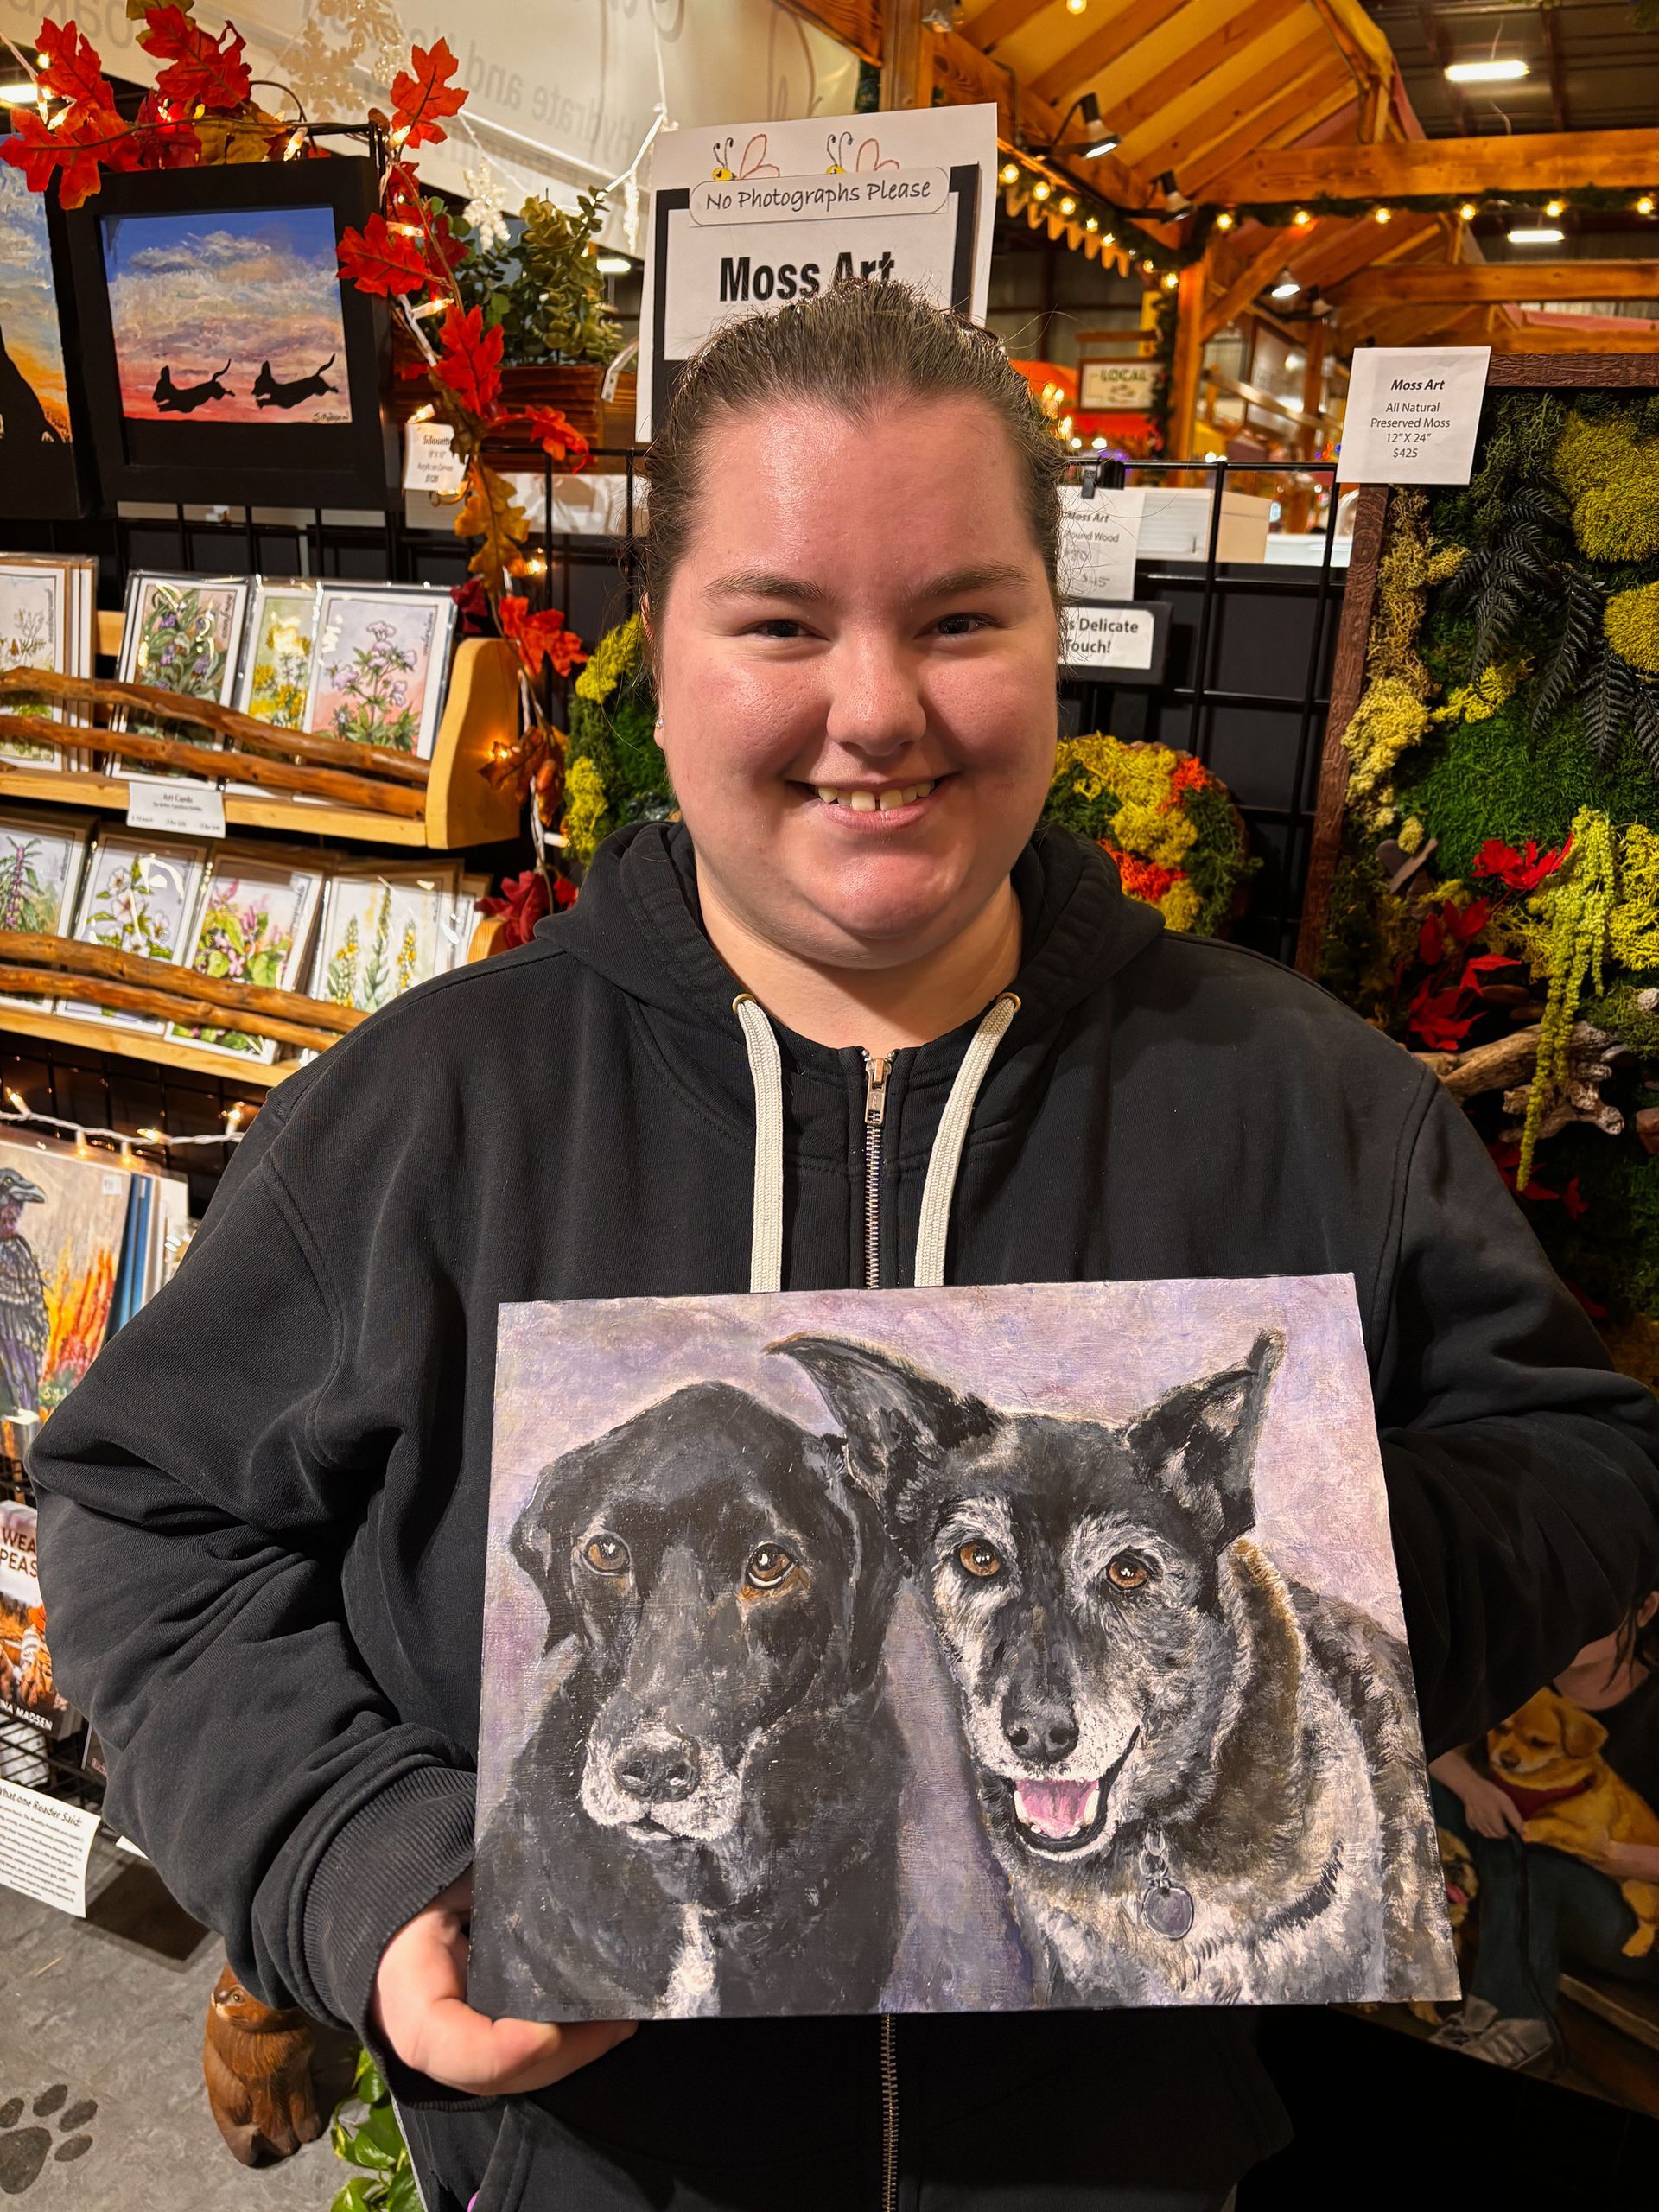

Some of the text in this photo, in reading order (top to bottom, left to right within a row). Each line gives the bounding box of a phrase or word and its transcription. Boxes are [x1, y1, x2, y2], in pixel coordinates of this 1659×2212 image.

[706, 180, 931, 213] No Photographs Please
[719, 257, 821, 302] Moss
[1100, 369, 1148, 382] LOCAL
[1390, 378, 1446, 391] Moss Art
[1385, 402, 1440, 413] All Natural
[1370, 417, 1451, 429] Preserved Moss
[1403, 433, 1412, 442] X
[1392, 448, 1419, 459] $425
[1092, 513, 1109, 523] Art
[1095, 532, 1120, 543] Wood
[1079, 618, 1139, 633] Delicate
[1066, 639, 1111, 654] Touch!
[16, 1707, 53, 1732] MADSEN
[16, 1796, 32, 1808] one
[33, 1800, 61, 1819] Reader
